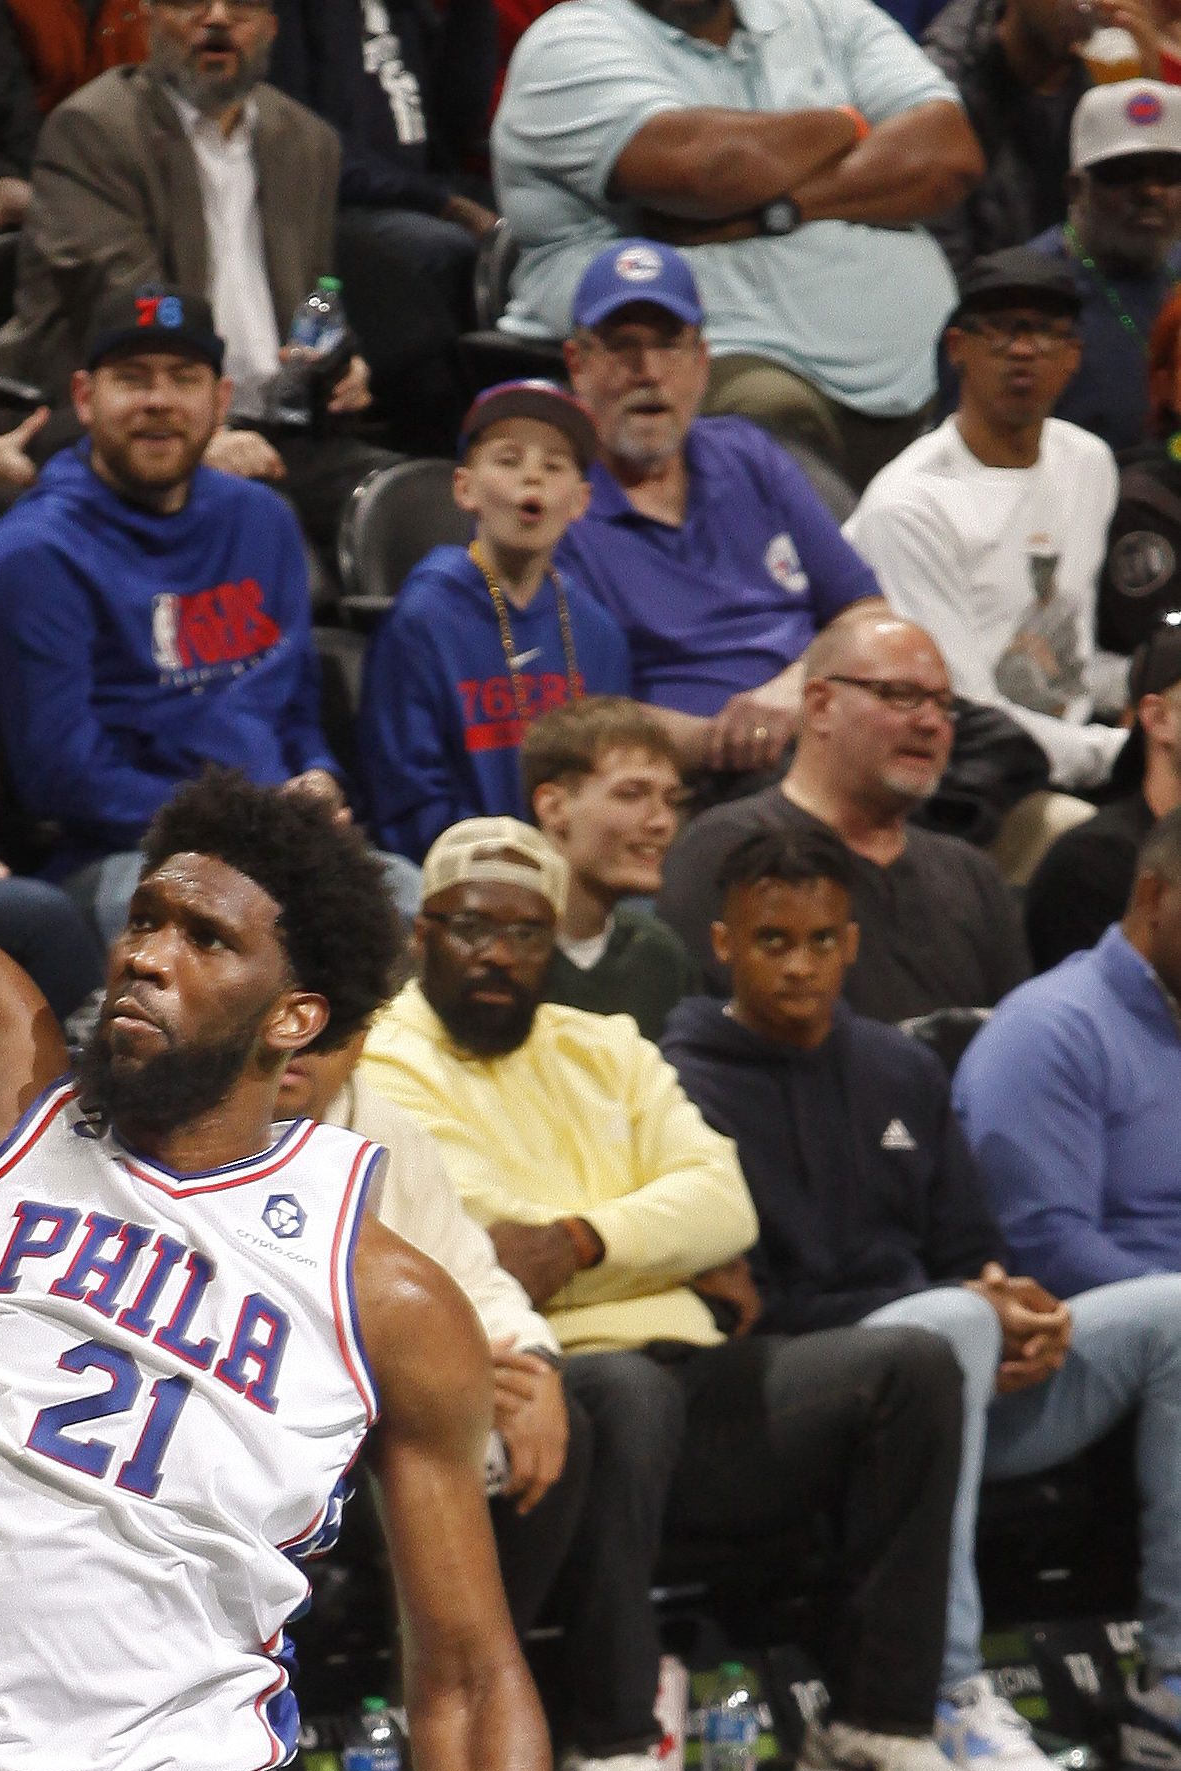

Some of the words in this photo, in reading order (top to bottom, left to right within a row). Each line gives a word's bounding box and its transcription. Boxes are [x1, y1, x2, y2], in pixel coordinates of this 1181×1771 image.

[134, 294, 184, 329] 76
[236, 1228, 318, 1268] crypto.com
[24, 1338, 195, 1499] 21
